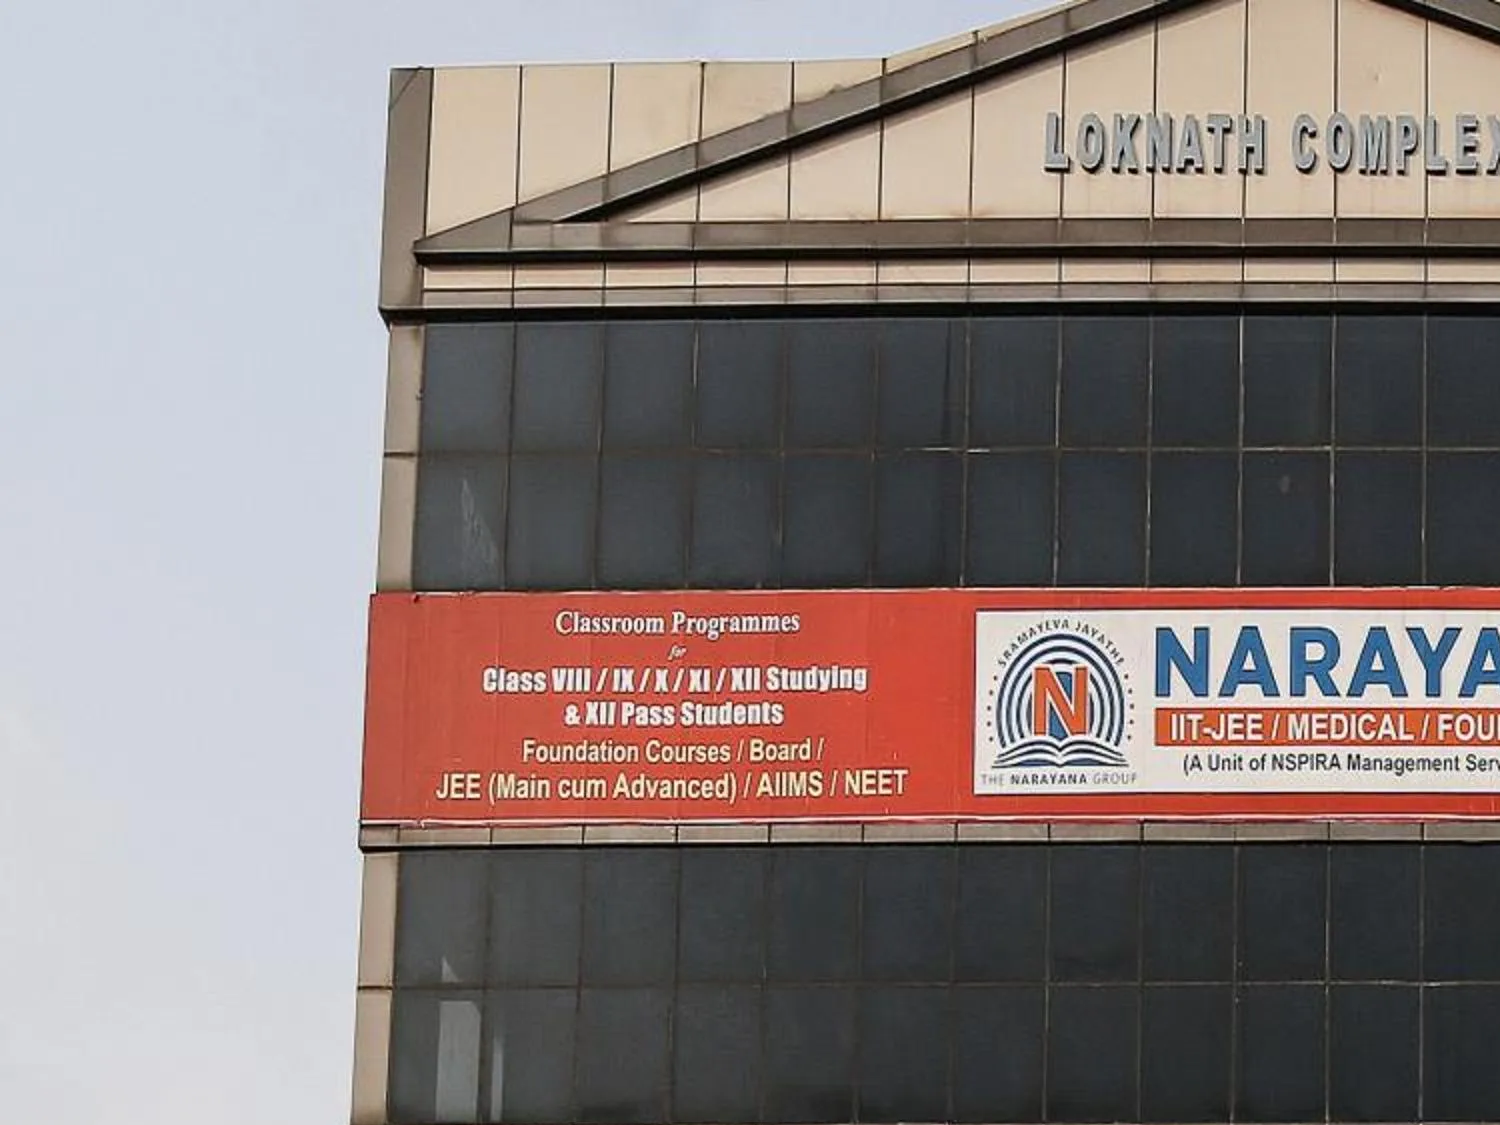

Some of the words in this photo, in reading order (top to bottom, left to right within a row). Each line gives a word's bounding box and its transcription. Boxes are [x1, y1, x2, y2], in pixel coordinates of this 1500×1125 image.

[1044, 112, 1267, 175] LOKNATH
[555, 611, 664, 635] Classroom
[672, 611, 800, 640] Programmes
[668, 644, 687, 660] for
[482, 667, 547, 692] Class
[552, 668, 591, 692] VIII
[612, 668, 634, 692] IX
[655, 667, 668, 691] X
[688, 667, 711, 691] XI
[731, 667, 761, 691] XII
[767, 666, 868, 692] Studying
[1034, 666, 1089, 736] N
[564, 704, 580, 726] &
[586, 703, 615, 726] XII
[621, 703, 674, 726] Pass
[681, 703, 783, 726] Students
[1169, 713, 1262, 744] IIT-JEE
[1287, 713, 1414, 743] MEDICAL
[522, 741, 640, 764] Foundation
[645, 741, 731, 764] Courses
[749, 739, 811, 761] Board
[1183, 752, 1201, 775] (A
[1208, 753, 1244, 773] Unit
[1250, 752, 1267, 773] of
[1271, 753, 1343, 773] NSPIRA
[1347, 753, 1460, 776] Management
[435, 774, 482, 799] JEE
[489, 774, 550, 804] (Main
[559, 779, 606, 799] cum
[612, 771, 737, 803] Advanced)
[756, 771, 823, 797] AIIMS
[844, 770, 909, 795] NEET
[1010, 773, 1087, 785] NARAYANA
